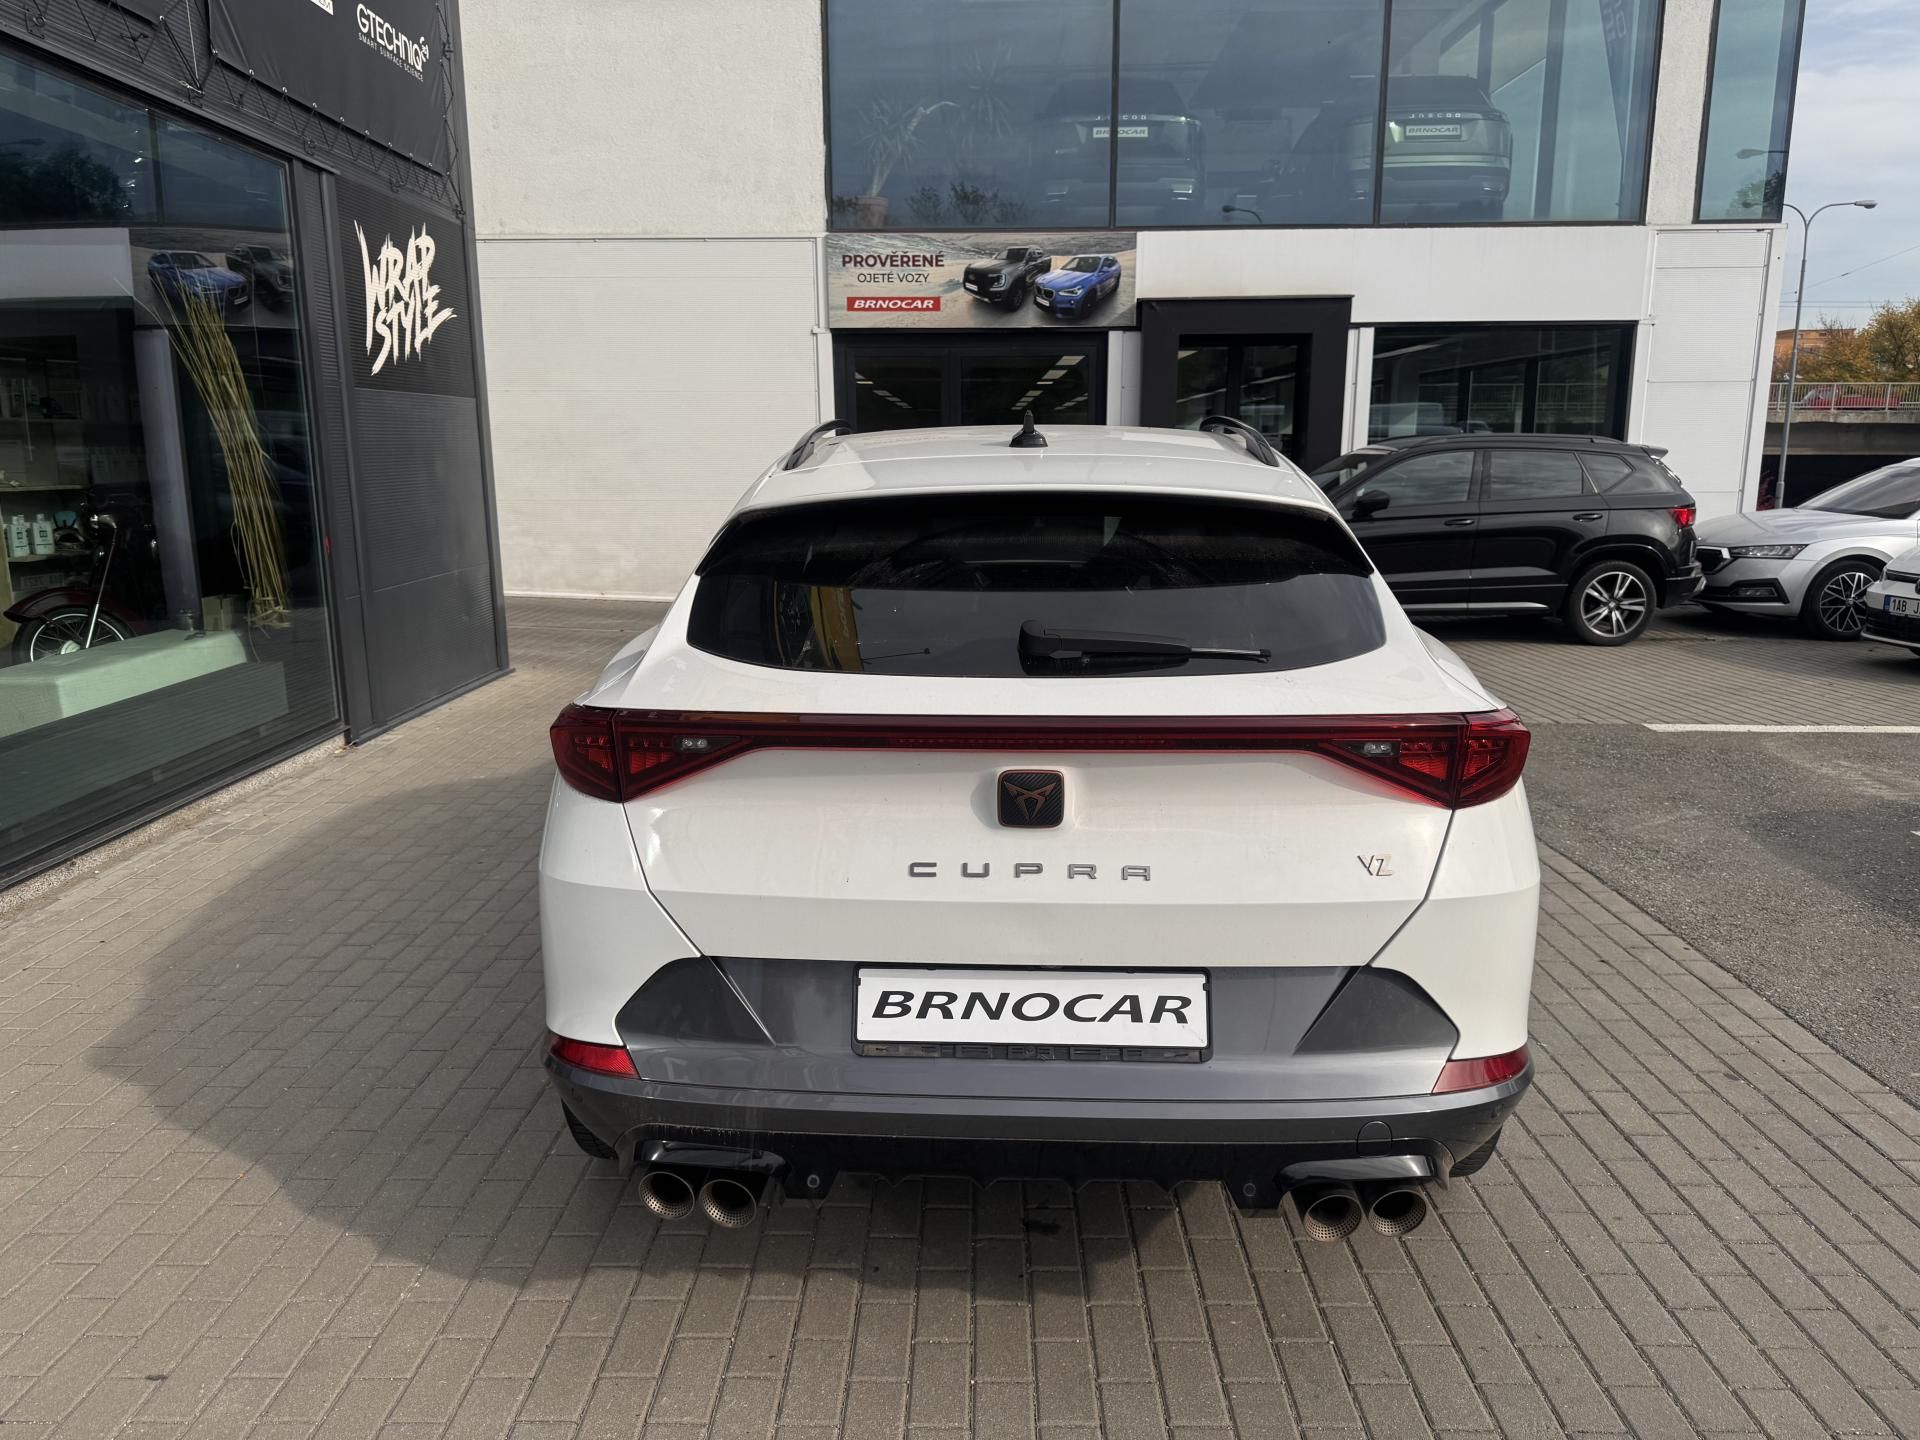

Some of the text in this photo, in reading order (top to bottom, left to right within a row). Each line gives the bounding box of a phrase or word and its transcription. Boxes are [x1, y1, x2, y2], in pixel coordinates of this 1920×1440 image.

[357, 3, 424, 72] GTECHNIQ
[358, 32, 378, 51] SMART
[1095, 128, 1147, 136] BROCAR
[841, 250, 945, 268] PROVĚŘENÉ
[857, 270, 930, 283] OJETÉ VOZY
[354, 220, 436, 356] WRAP
[853, 299, 935, 309] BRNOCAR
[371, 285, 458, 376] STYLE
[1892, 598, 1920, 615] 1AB J
[908, 861, 1152, 881] CUPRA
[1356, 853, 1393, 877] VZ
[871, 990, 1193, 1025] BRNOCAR
